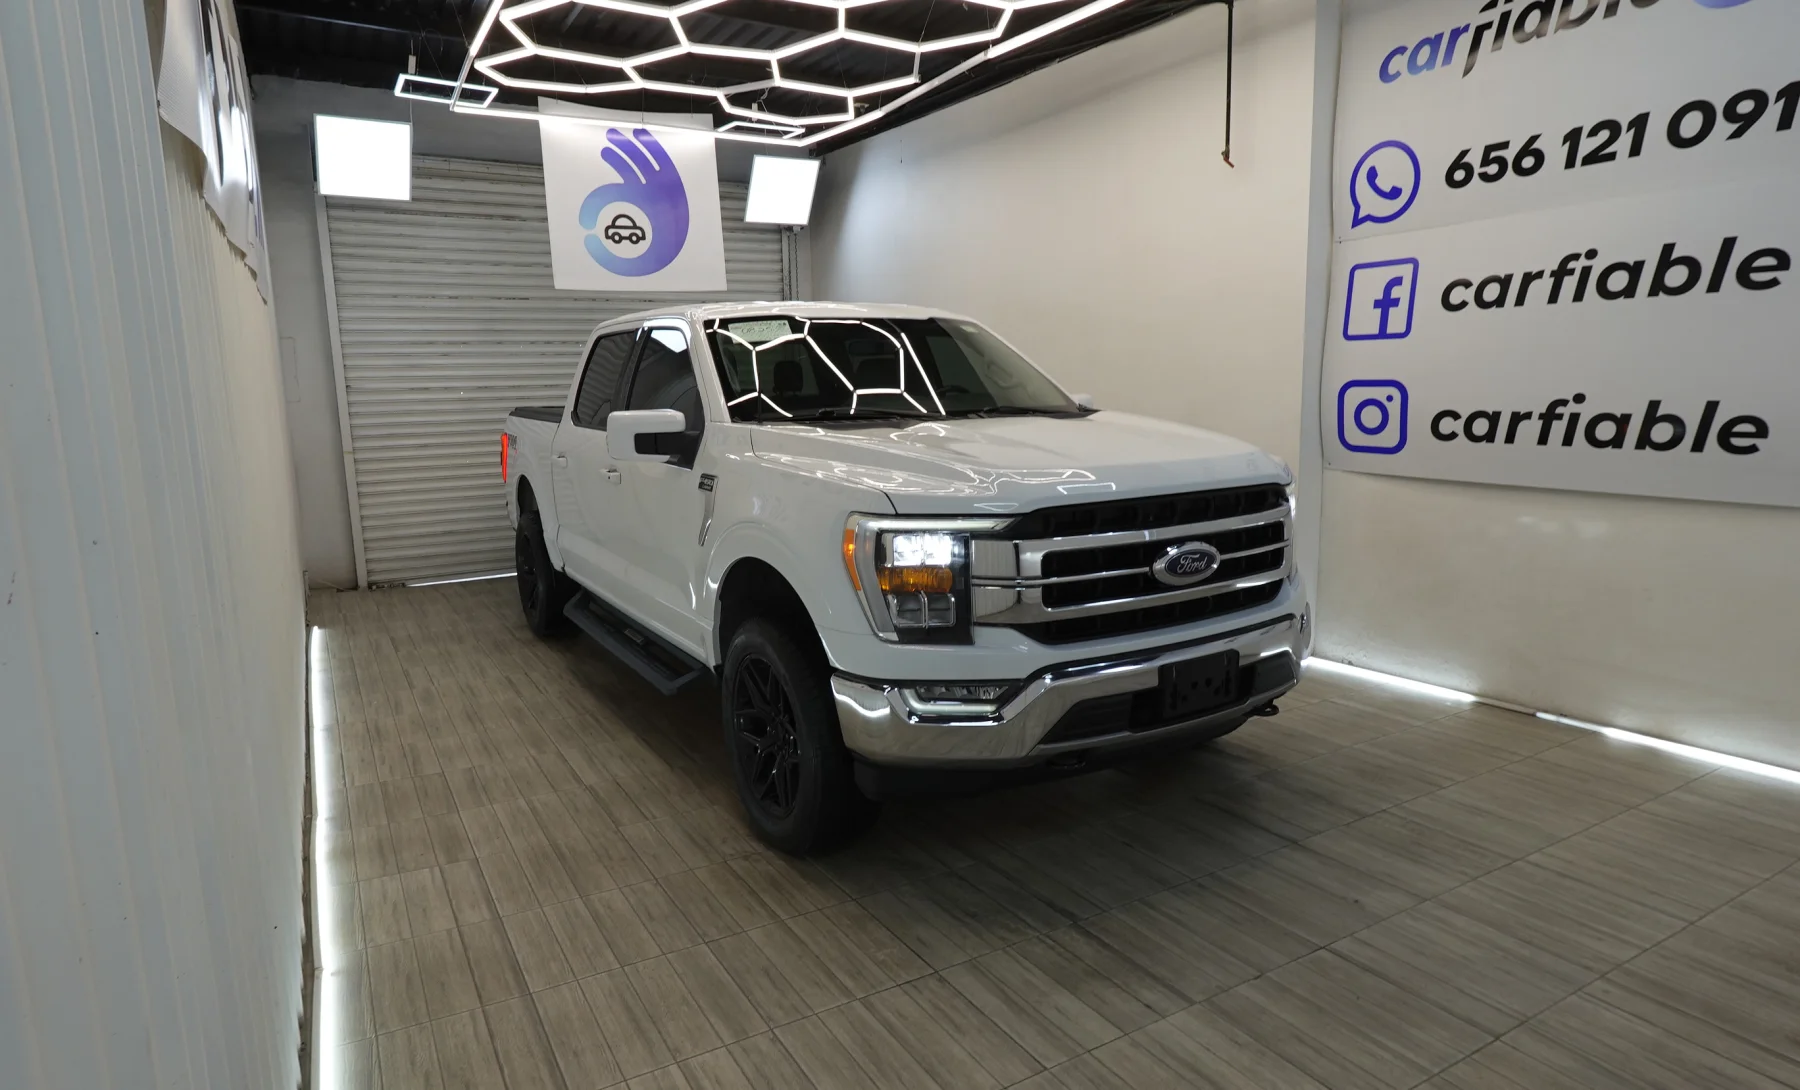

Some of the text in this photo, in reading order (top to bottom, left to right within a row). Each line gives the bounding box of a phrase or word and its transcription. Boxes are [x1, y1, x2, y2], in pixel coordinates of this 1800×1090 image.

[1379, 0, 1660, 84] carfia
[1444, 80, 1800, 190] 656 121 091
[1440, 235, 1793, 313] carfiable
[1430, 392, 1770, 456] carfiable
[1177, 553, 1208, 574] Ford
